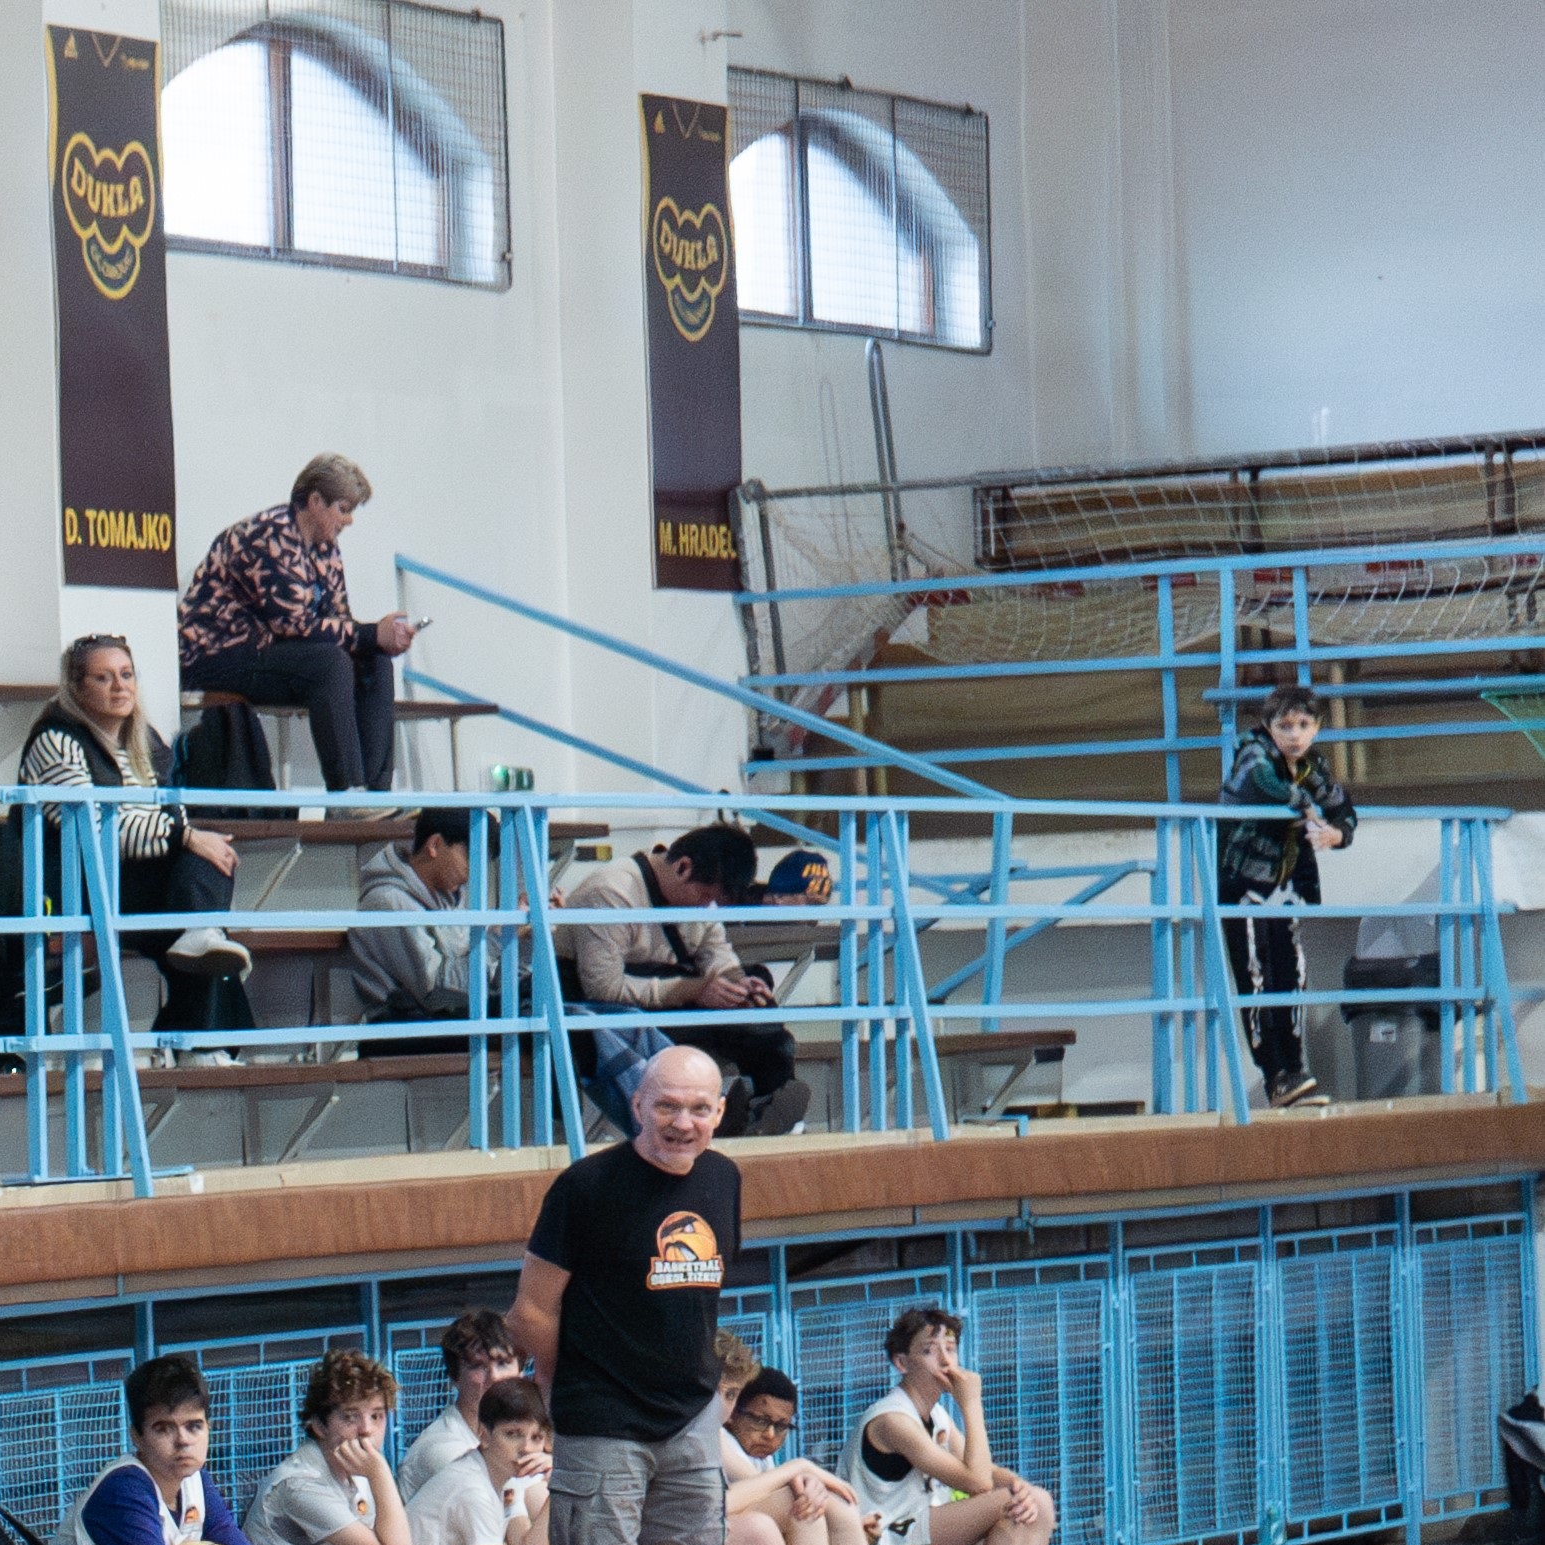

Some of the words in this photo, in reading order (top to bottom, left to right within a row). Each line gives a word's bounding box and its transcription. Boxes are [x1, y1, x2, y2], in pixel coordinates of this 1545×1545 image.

[64, 507, 83, 546] D.
[84, 508, 172, 552] TOMAJKO
[659, 519, 677, 556] M.
